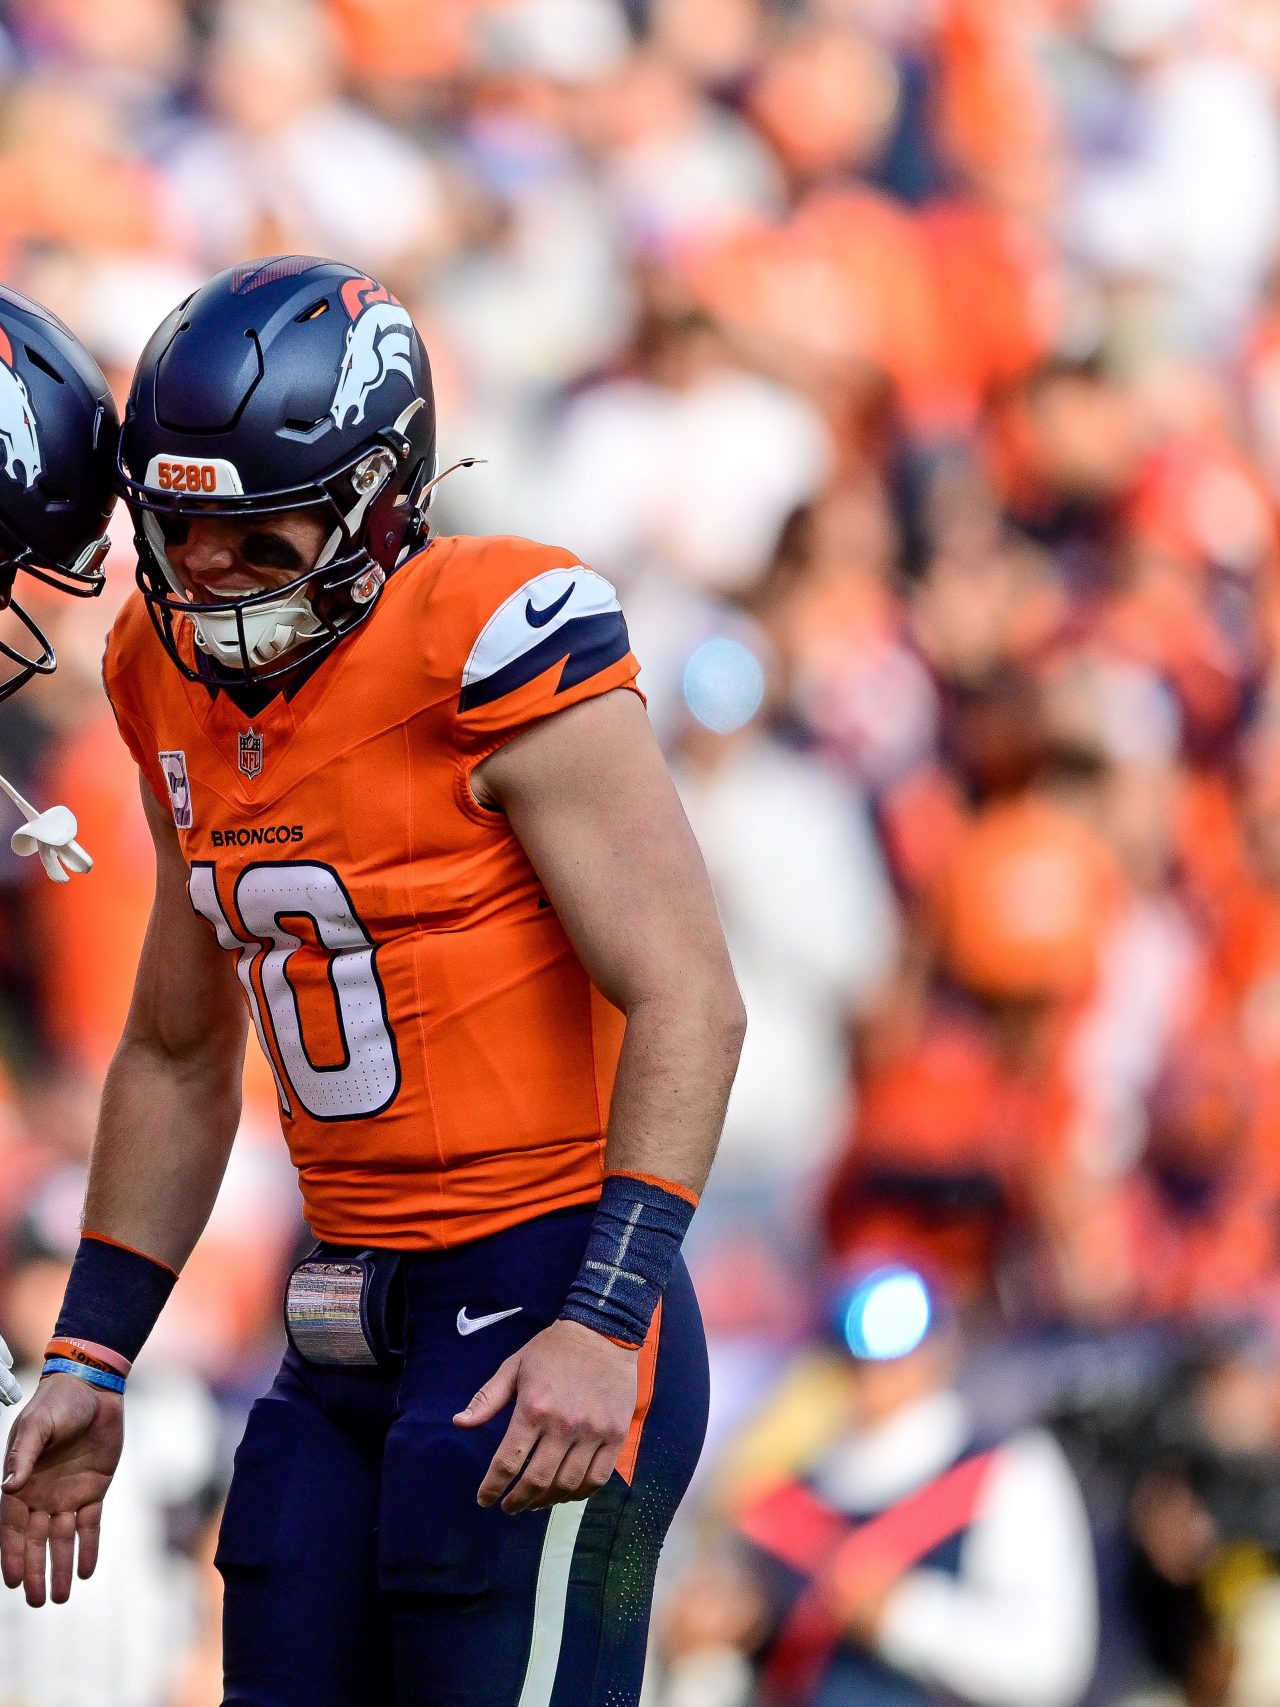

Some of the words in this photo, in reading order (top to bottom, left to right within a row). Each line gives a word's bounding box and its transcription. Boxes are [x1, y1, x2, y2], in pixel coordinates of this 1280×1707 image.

[157, 462, 217, 492] 5280
[241, 750, 259, 769] NFL
[210, 825, 304, 847] BRONCOS
[188, 860, 401, 1122] 10
